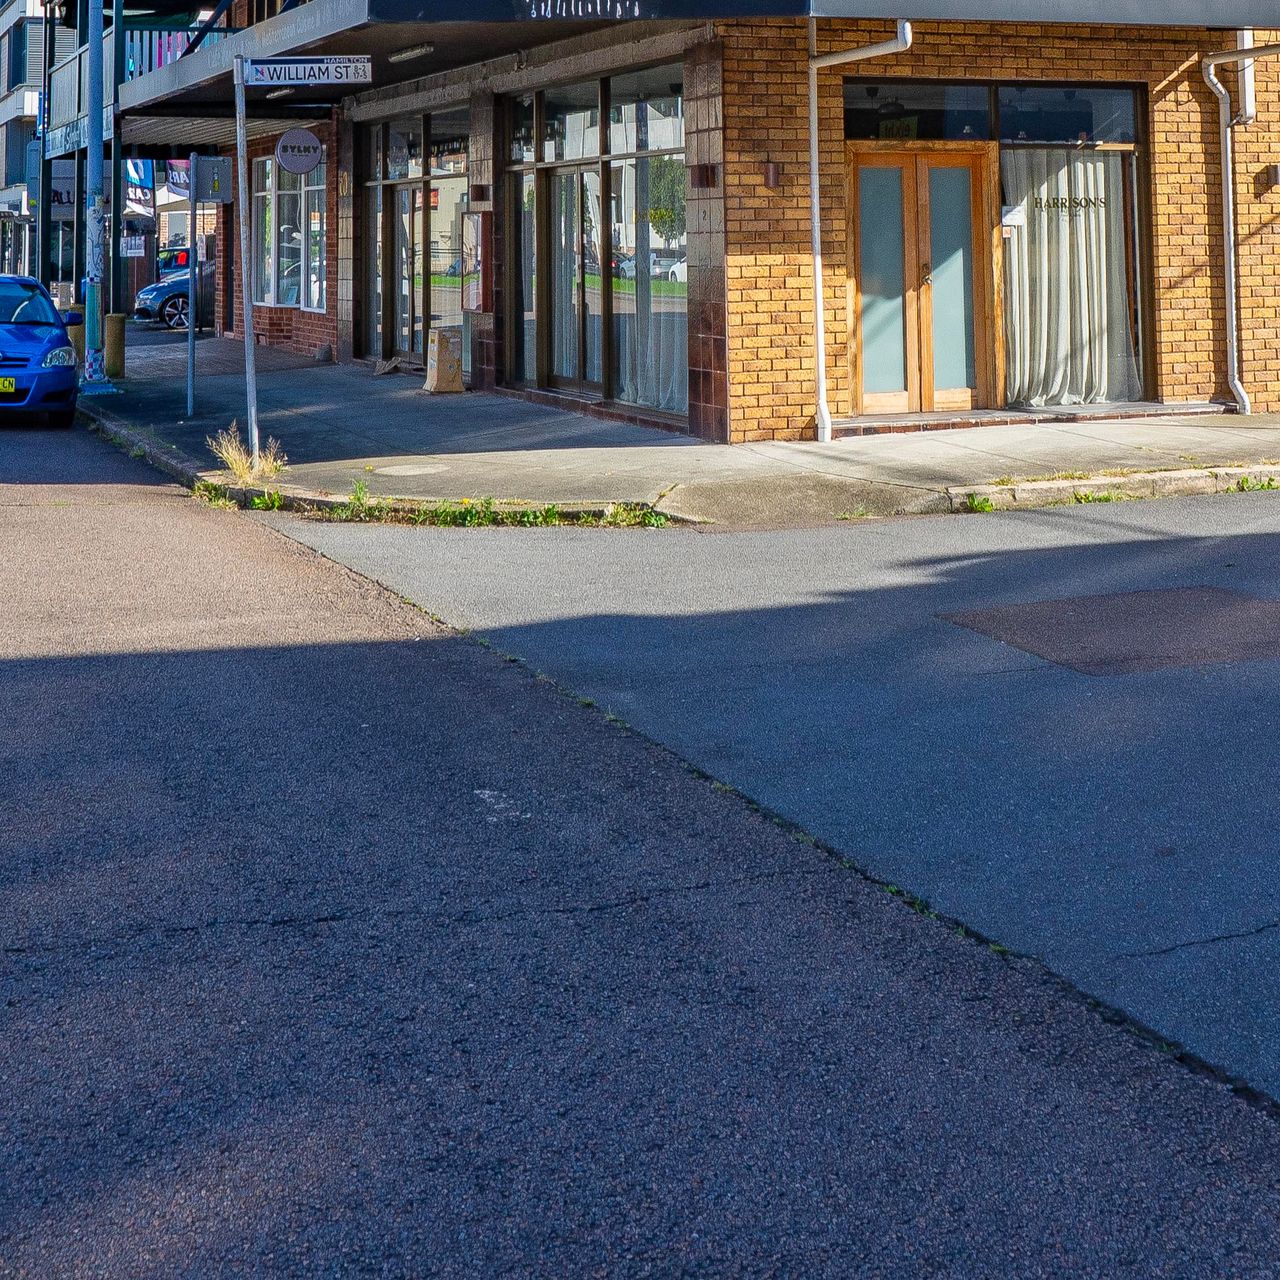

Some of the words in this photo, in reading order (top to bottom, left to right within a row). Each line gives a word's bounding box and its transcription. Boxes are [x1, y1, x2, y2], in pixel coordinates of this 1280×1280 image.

[267, 66, 330, 81] WILLIAM
[334, 65, 351, 80] ST
[1034, 197, 1107, 209] HARRISON'S
